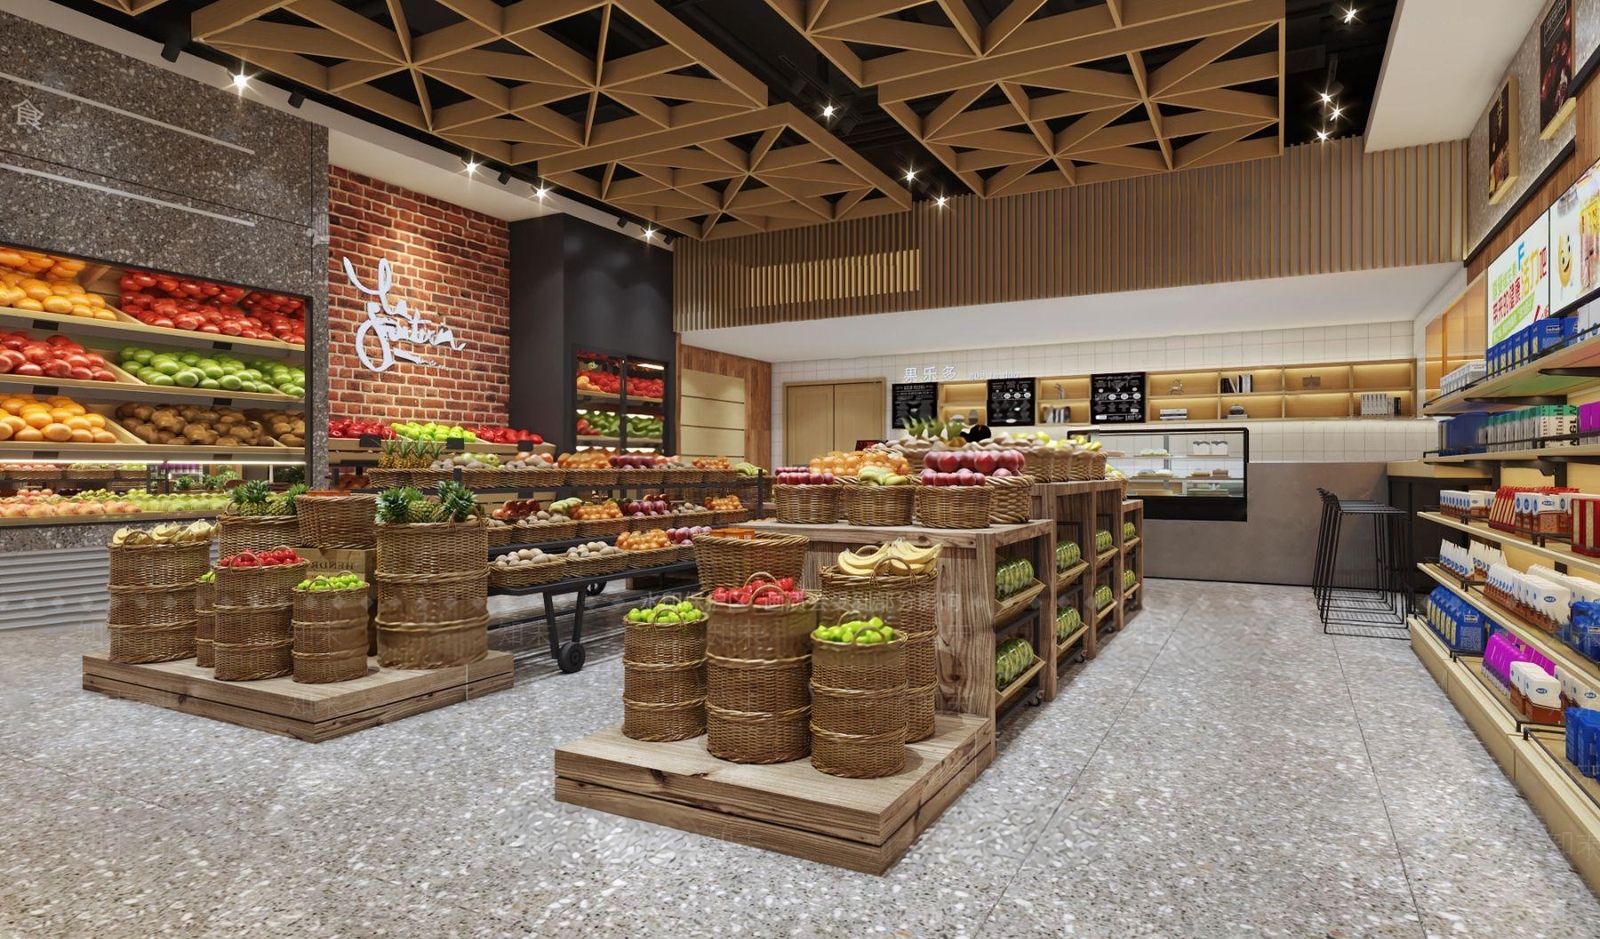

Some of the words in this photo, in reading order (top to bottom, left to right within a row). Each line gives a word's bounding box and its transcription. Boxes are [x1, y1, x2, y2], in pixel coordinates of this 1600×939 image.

[12, 100, 44, 130] 食
[904, 365, 956, 383] 果乐多
